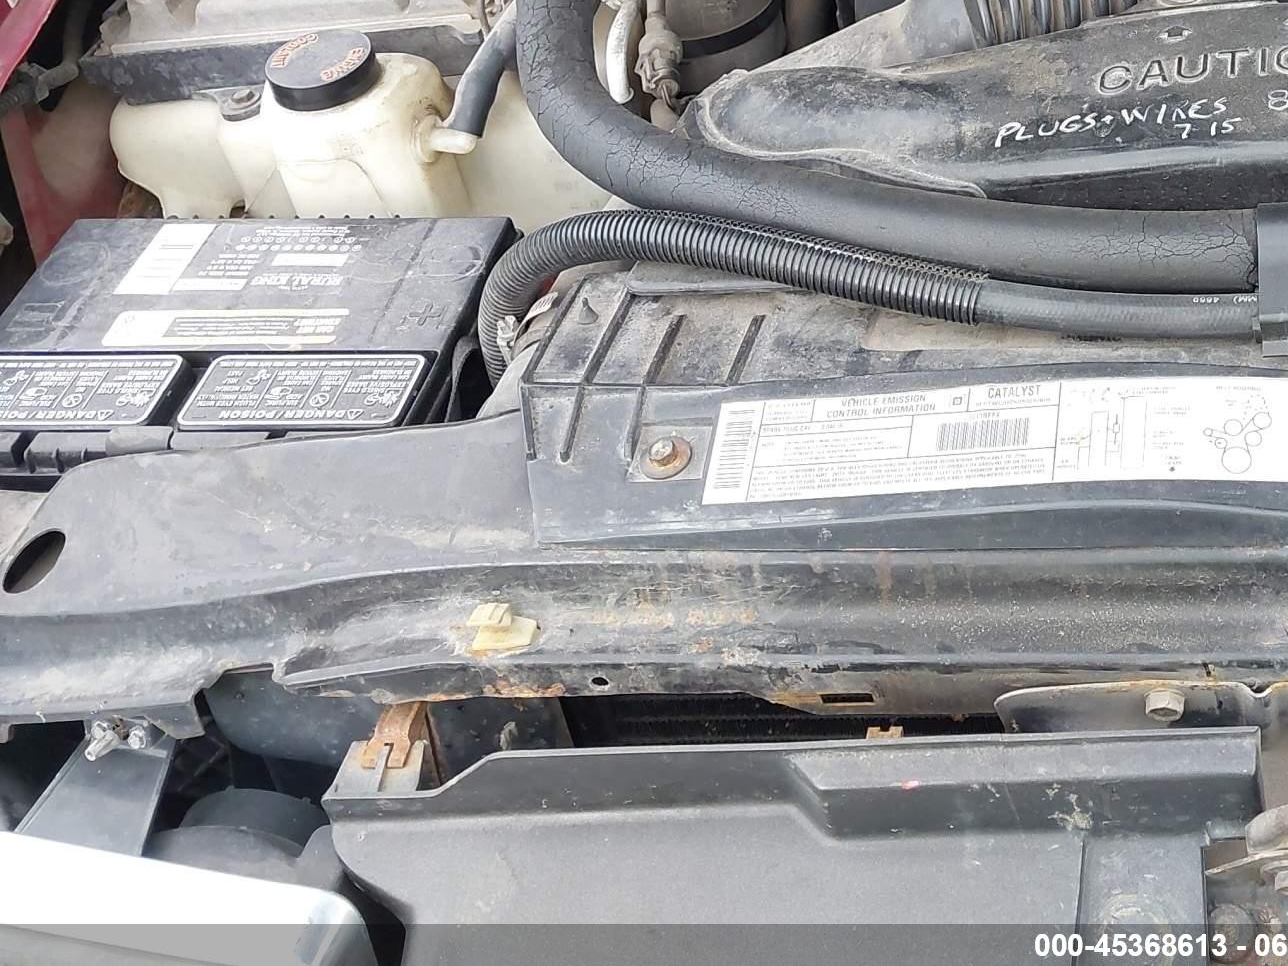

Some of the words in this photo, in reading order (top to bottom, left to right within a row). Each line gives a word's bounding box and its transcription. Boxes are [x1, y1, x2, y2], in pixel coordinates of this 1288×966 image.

[250, 275, 289, 285] KING
[291, 275, 343, 285] RURAL
[841, 397, 879, 407] VEHICLE
[882, 394, 926, 405] EMISSION
[988, 385, 1041, 399] CATALYST
[219, 409, 345, 419] DANGER/POISON
[827, 408, 870, 418] CONTROL
[873, 404, 936, 416] INFORMATION
